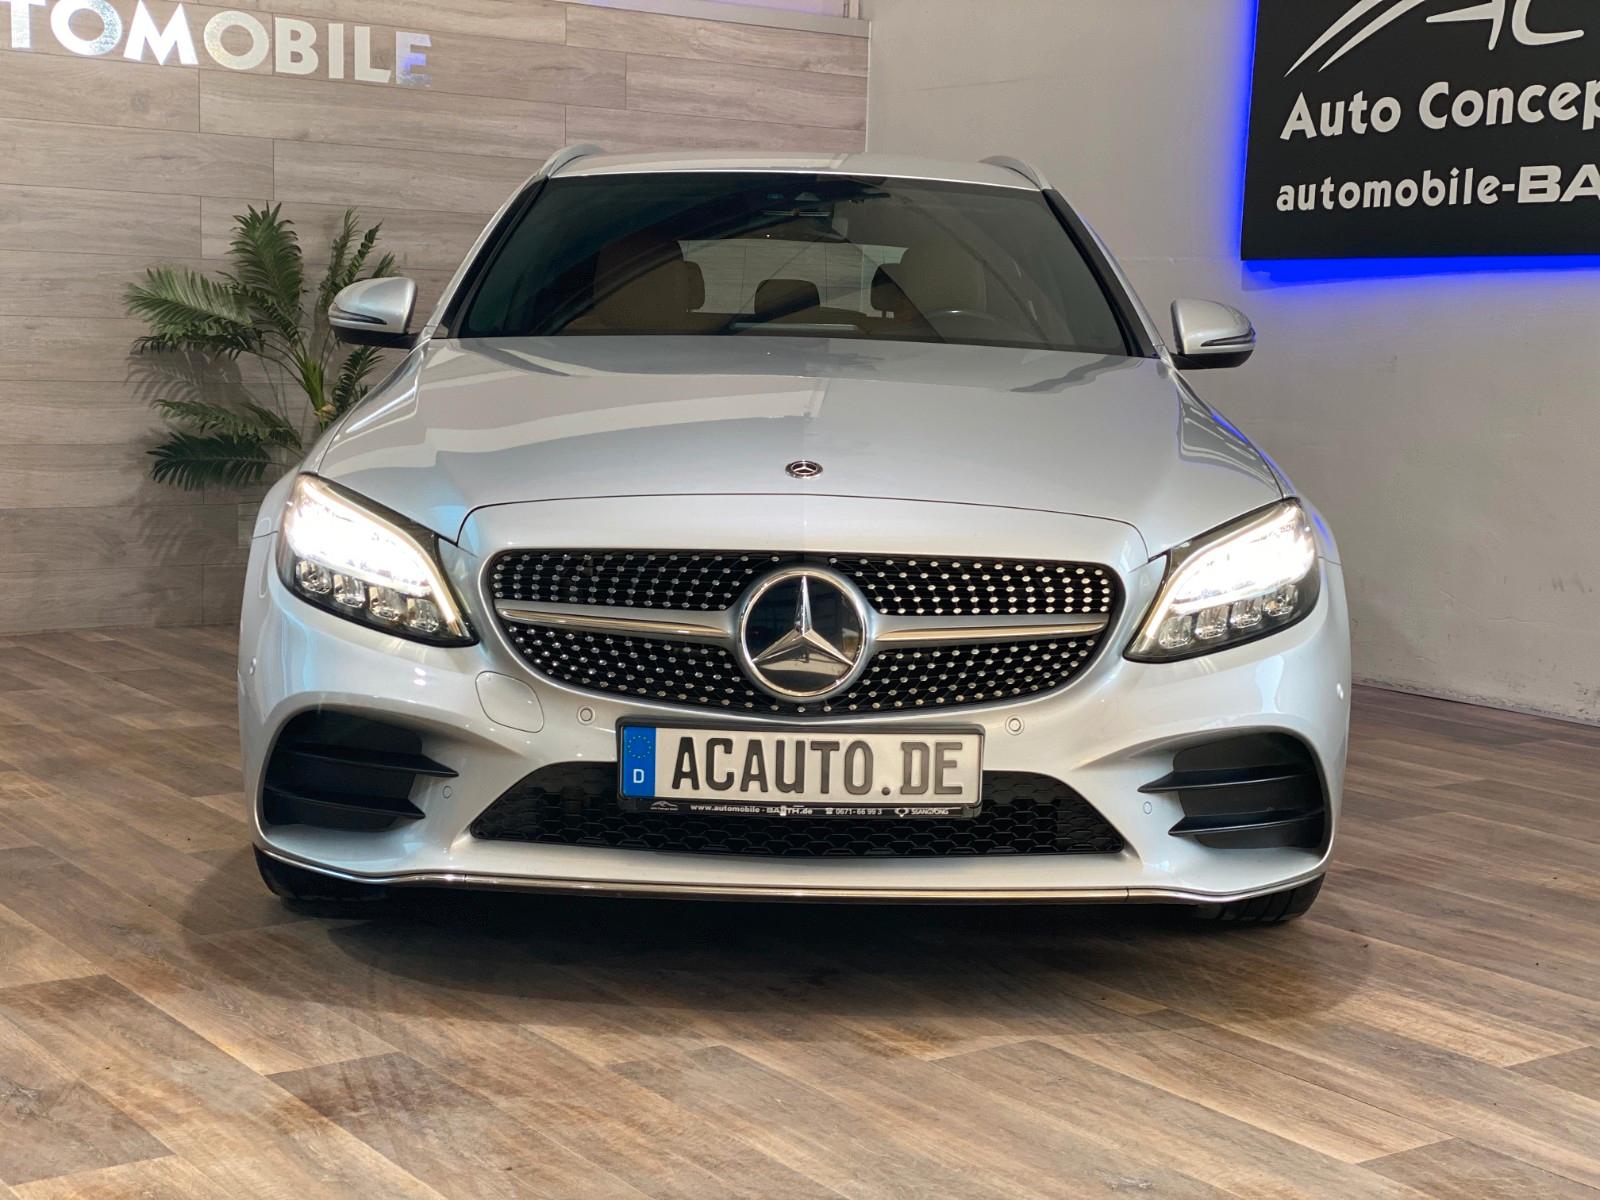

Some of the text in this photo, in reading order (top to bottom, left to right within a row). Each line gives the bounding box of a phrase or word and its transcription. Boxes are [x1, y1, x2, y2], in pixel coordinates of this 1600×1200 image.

[1280, 91, 1401, 140] Auto
[633, 769, 645, 784] D
[671, 736, 963, 795] ACAUTO.DE
